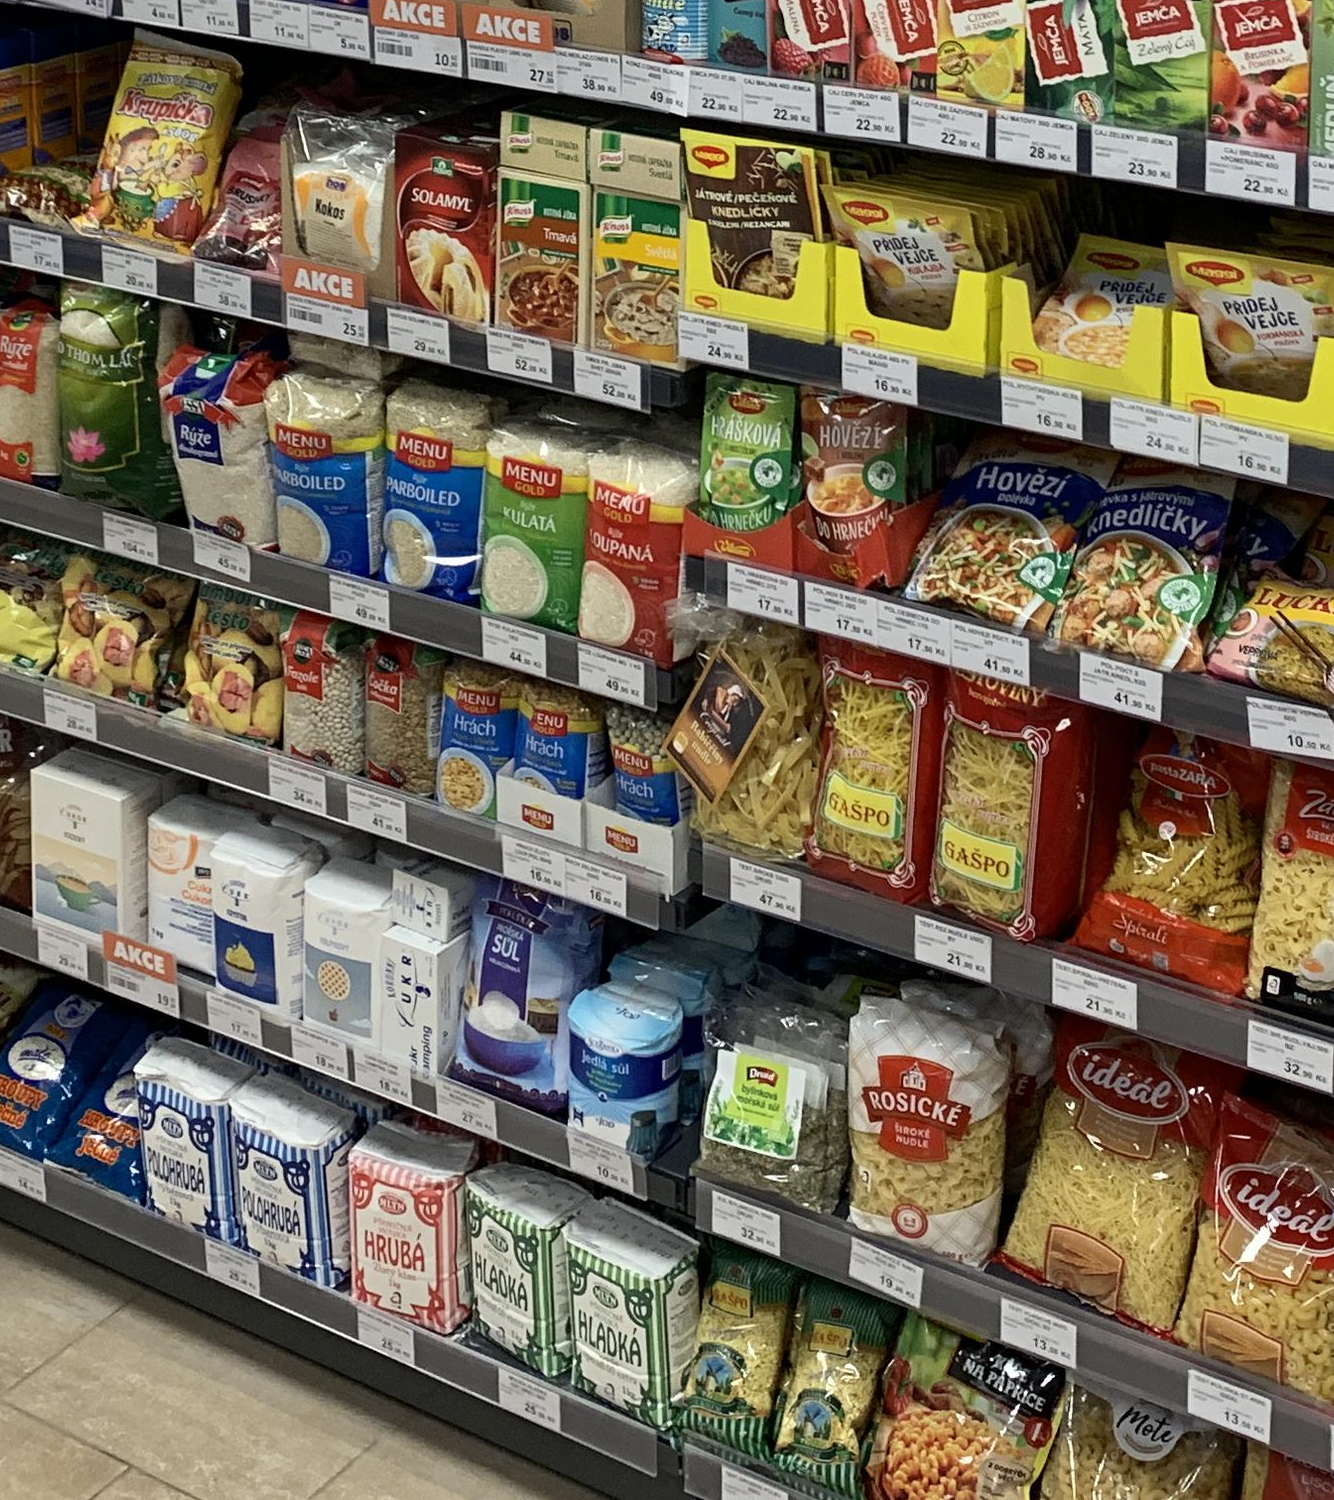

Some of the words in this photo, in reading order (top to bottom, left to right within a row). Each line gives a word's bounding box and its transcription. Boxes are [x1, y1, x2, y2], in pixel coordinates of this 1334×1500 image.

[475, 12, 541, 45] AKCE
[967, 8, 1004, 26] CITRON
[117, 87, 213, 127] Krupička
[315, 198, 345, 221] Kokos
[411, 187, 473, 213] SOLAMYL
[711, 203, 780, 219] KNEDLIČKY
[543, 226, 577, 246] Tmavá
[872, 237, 920, 256] PŘIDEJ
[892, 248, 939, 266] VEJCE
[293, 268, 353, 299] AKCE
[276, 429, 328, 450] MENU
[711, 416, 781, 447] HRÁŠKOVÁ
[504, 463, 557, 488] MENU
[975, 463, 1067, 500] Hovězí
[386, 477, 461, 508] PARBOILED
[503, 505, 557, 535] KULATÁ
[453, 713, 496, 738] Hrách
[943, 837, 1011, 879] GAŠPO
[1112, 915, 1169, 946] Spirali
[113, 941, 166, 976] AKCE
[492, 934, 521, 962] SŮL
[582, 1049, 608, 1068] Jedlá
[611, 1062, 629, 1076] sůl
[1081, 1059, 1171, 1110] ideál
[868, 1088, 963, 1127] ROSICKÉ
[895, 1133, 929, 1150] NUDLE
[241, 1186, 301, 1238] POLOHRUBÁ
[365, 1228, 426, 1274] HRUBÁ
[578, 1309, 642, 1368] HLADKÁ
